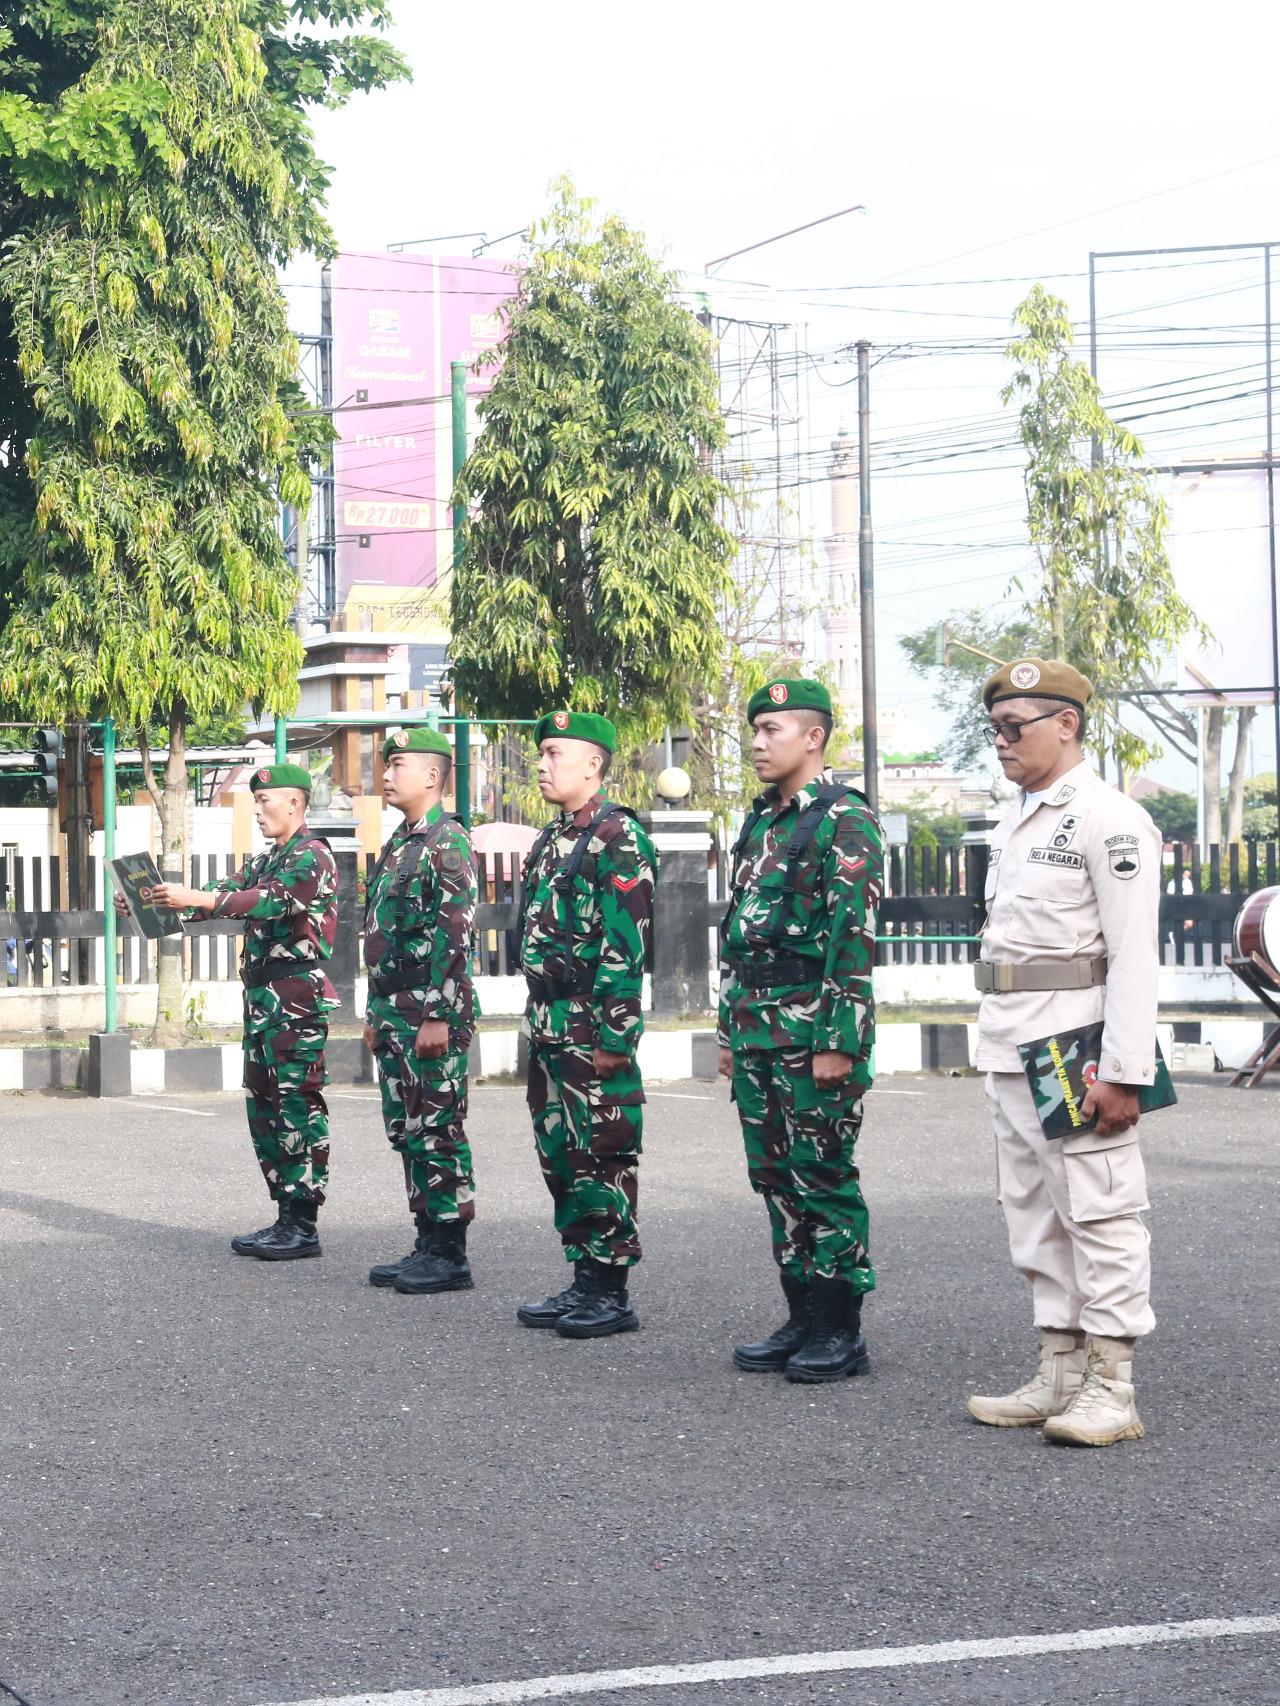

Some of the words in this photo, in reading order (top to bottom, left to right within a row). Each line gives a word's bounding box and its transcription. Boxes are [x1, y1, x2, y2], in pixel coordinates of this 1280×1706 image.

[355, 434, 417, 449] FILTER
[1030, 850, 1046, 861] BELA
[1047, 853, 1079, 867] NEGARA
[1058, 1068, 1073, 1103] PRASETYA
